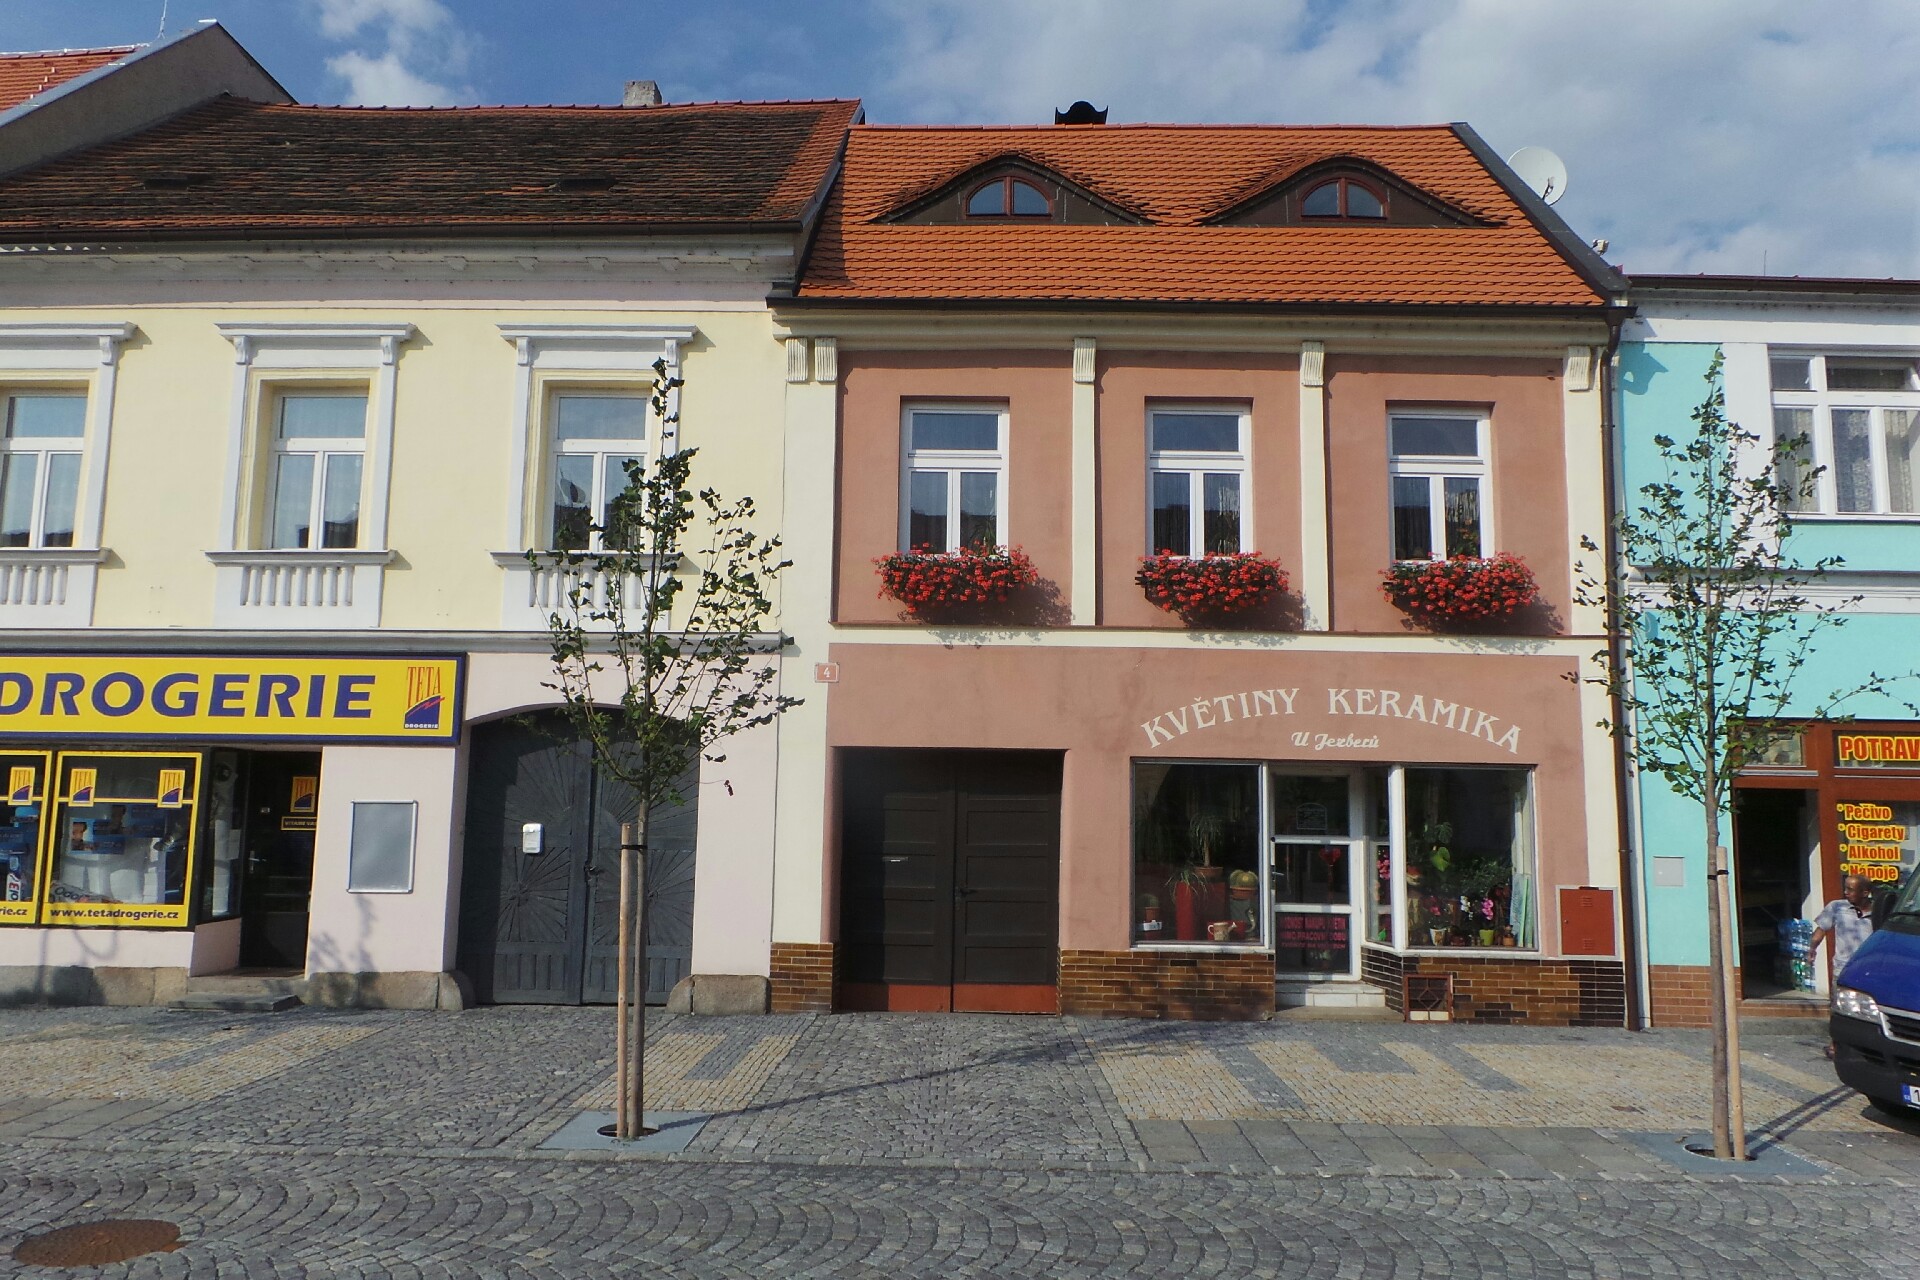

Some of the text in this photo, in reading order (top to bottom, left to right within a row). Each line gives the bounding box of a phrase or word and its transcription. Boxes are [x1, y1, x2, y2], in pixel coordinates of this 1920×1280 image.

[823, 666, 831, 678] 4
[0, 671, 376, 718] DROGERIE
[407, 666, 441, 709] TETA
[1141, 687, 1521, 754] KVĚTINY KERAMIKA
[1291, 731, 1310, 746] U
[1845, 804, 1891, 819] Pečivo
[1847, 825, 1905, 840] Cigarety
[1848, 845, 1899, 859] Alkohol
[50, 908, 179, 920] www.tetadrogerie.cz
